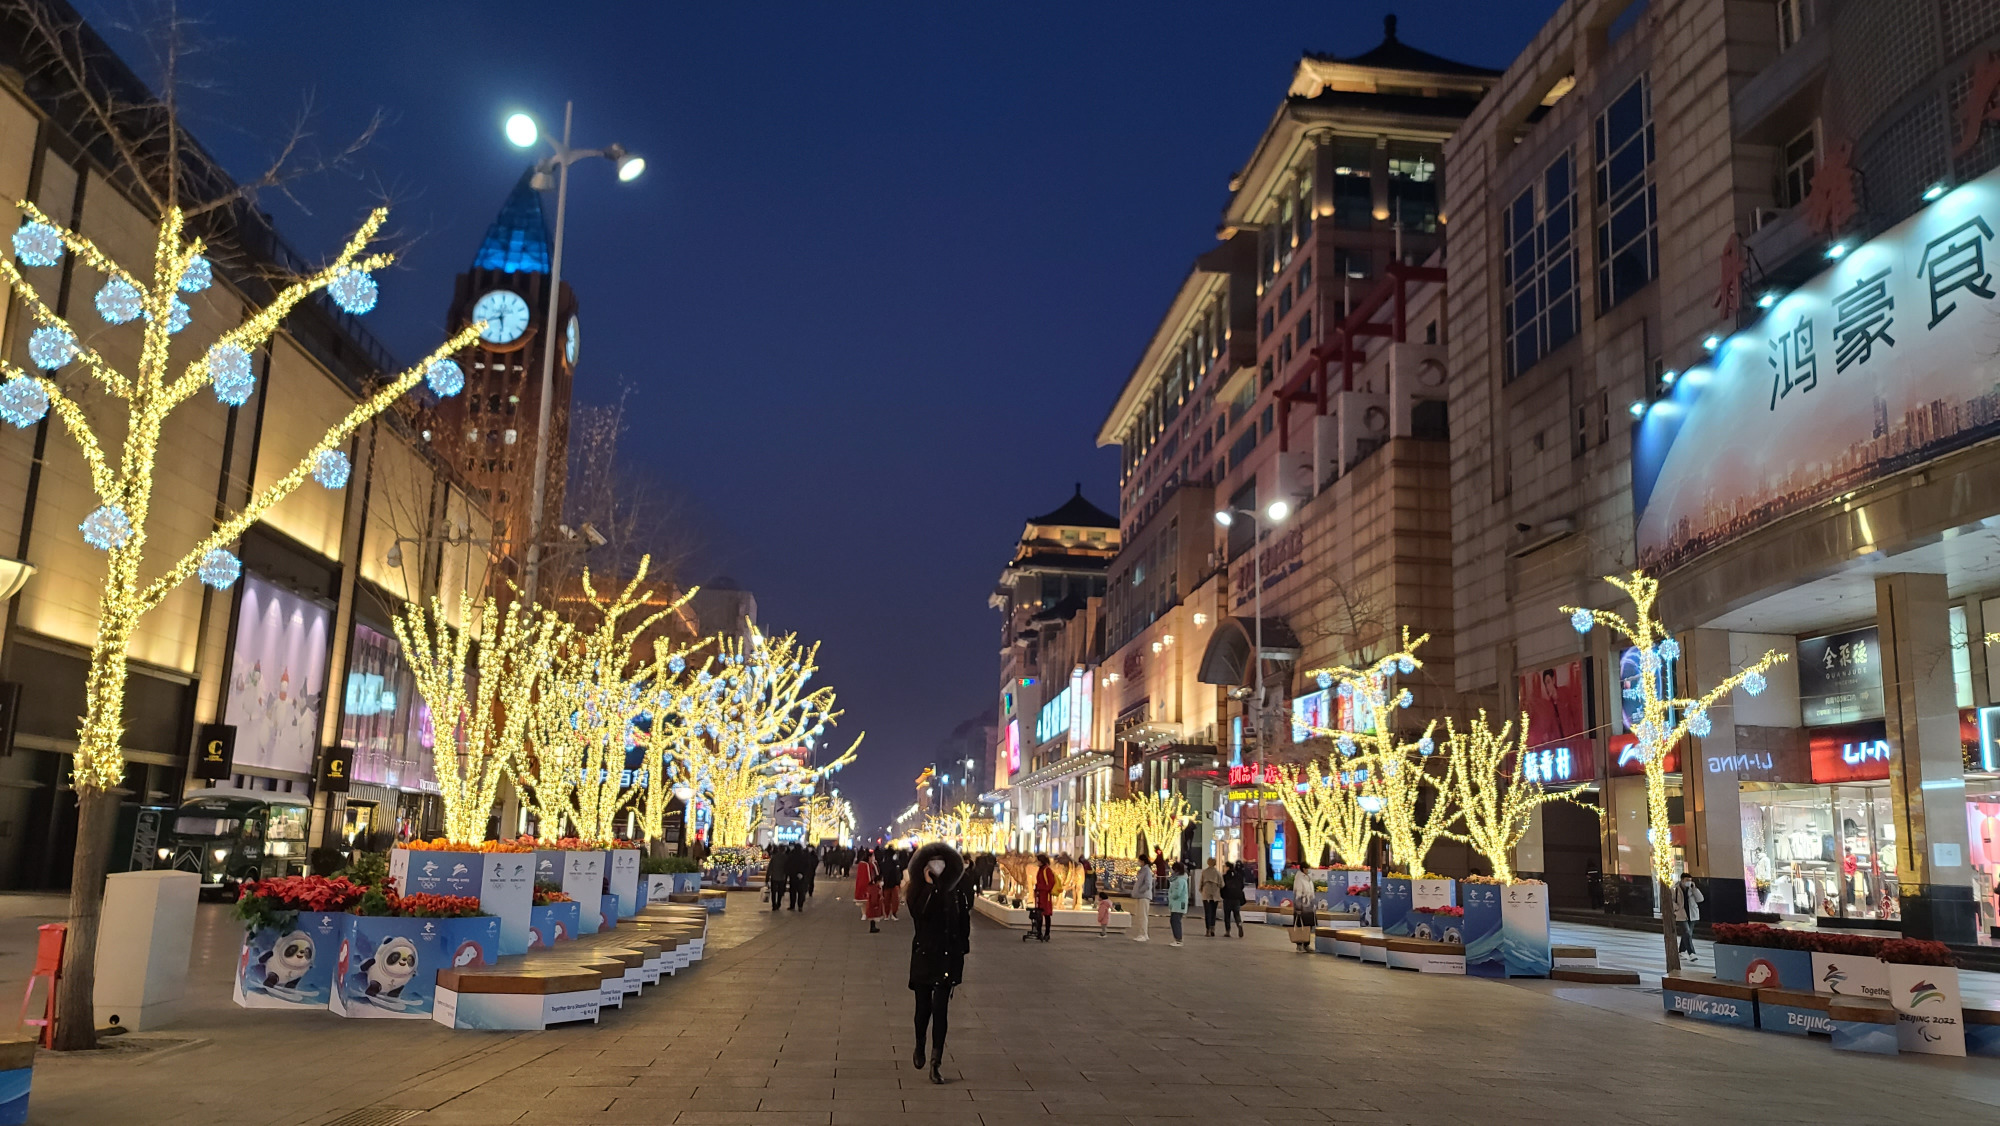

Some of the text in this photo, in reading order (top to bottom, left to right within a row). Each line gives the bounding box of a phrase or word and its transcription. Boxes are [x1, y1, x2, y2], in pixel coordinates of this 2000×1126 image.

[1769, 215, 1997, 411] 鸿豪食
[1825, 667, 1868, 680] QUANJUDE
[1253, 789, 1278, 800] Sore
[1674, 995, 1739, 1018] BEIJING 2022
[1787, 1012, 1831, 1031] BEIJING
[1899, 1013, 1956, 1025] BEIJING 2022
